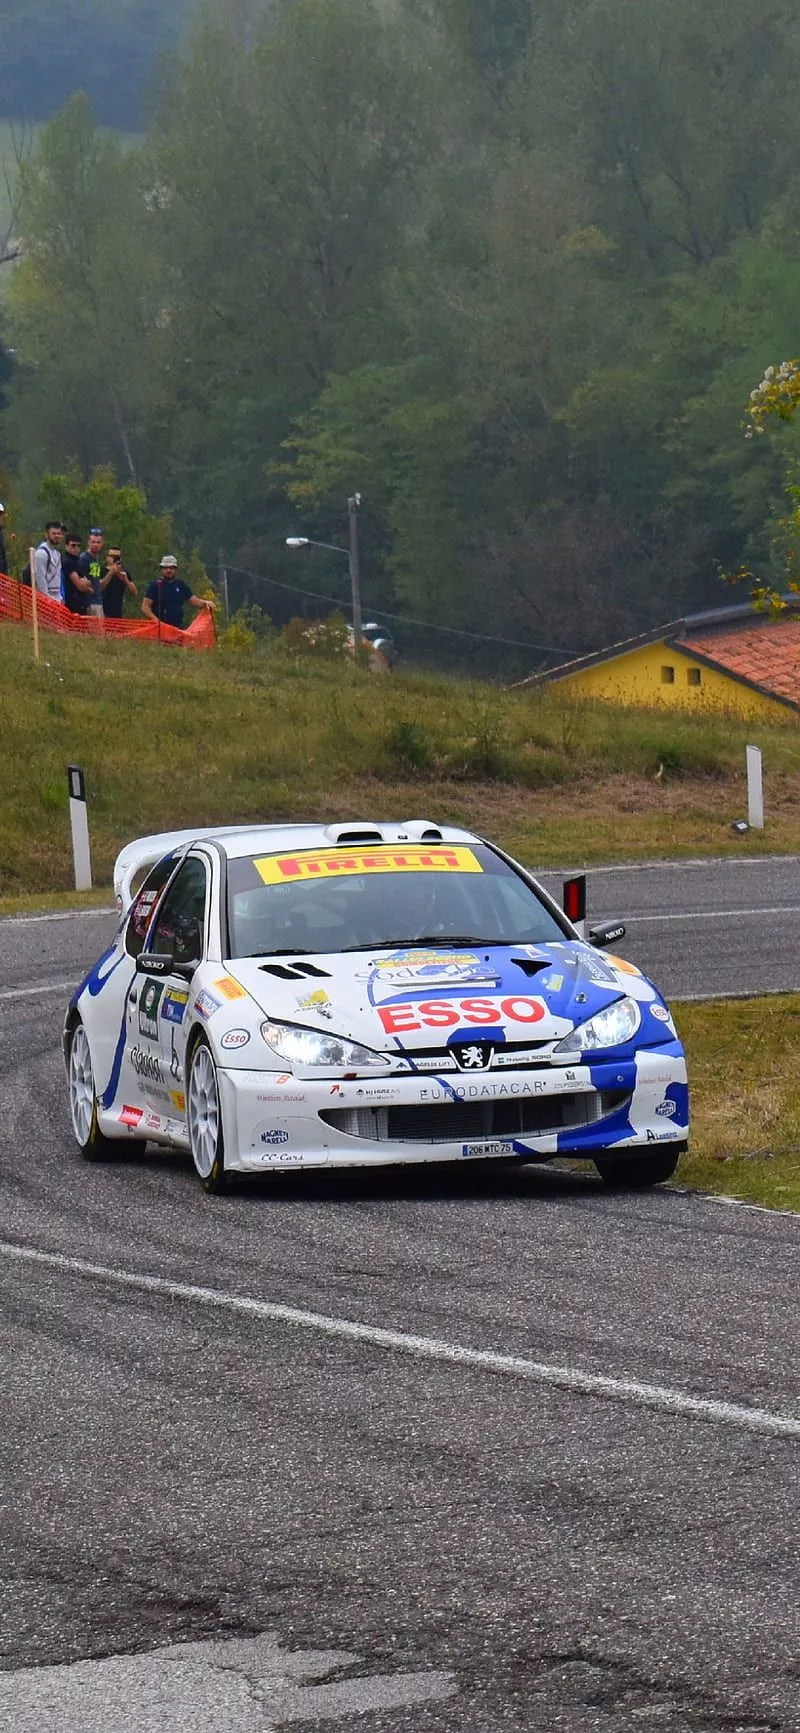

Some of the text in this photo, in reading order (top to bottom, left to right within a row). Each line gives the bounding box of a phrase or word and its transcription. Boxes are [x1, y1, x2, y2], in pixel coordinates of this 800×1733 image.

[276, 850, 460, 877] PIRELLI
[377, 997, 545, 1034] ESSO
[420, 1081, 543, 1100] EURODATACAR
[469, 1143, 511, 1154] 206 MTC 75
